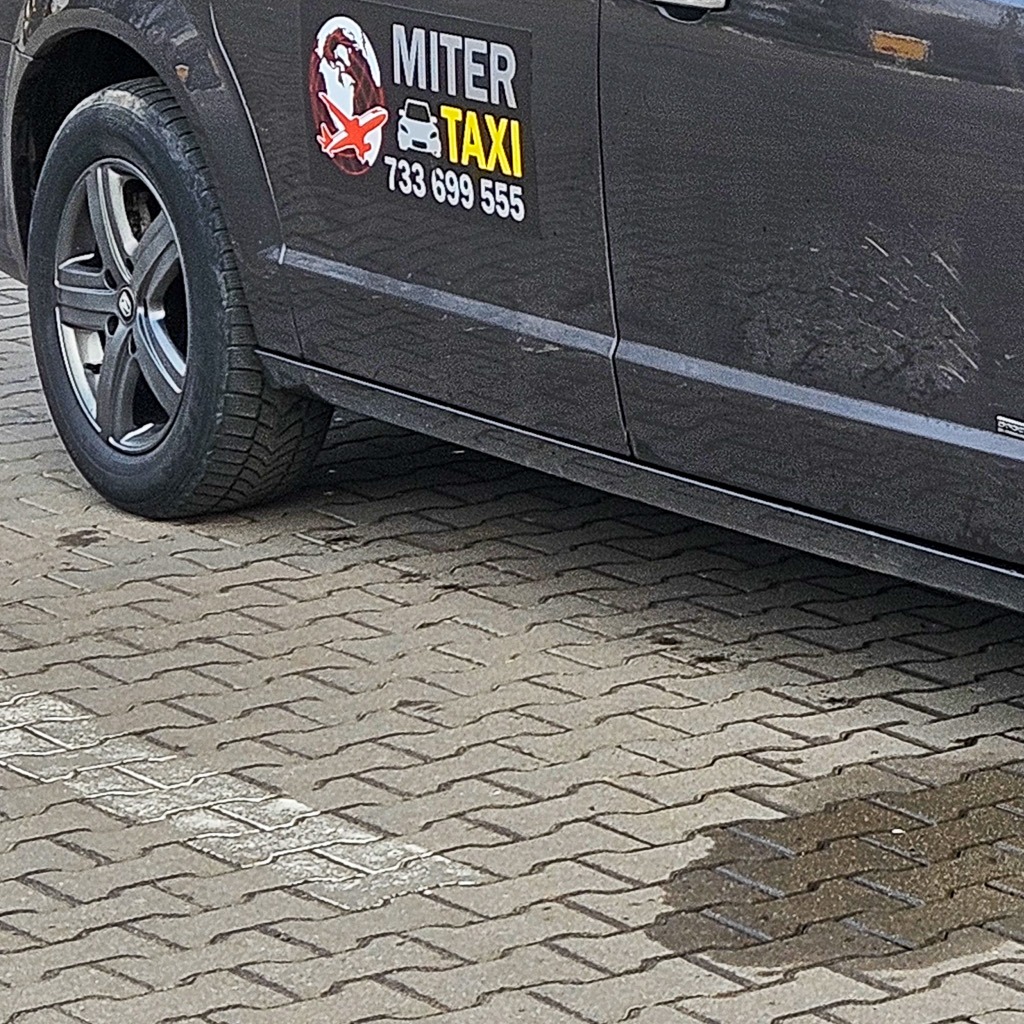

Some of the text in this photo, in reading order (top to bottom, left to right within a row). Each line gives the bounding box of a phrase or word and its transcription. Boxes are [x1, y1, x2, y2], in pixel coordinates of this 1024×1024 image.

[393, 23, 518, 109] MITER
[440, 105, 523, 178] TAXI
[384, 156, 525, 222] 733 699 555
